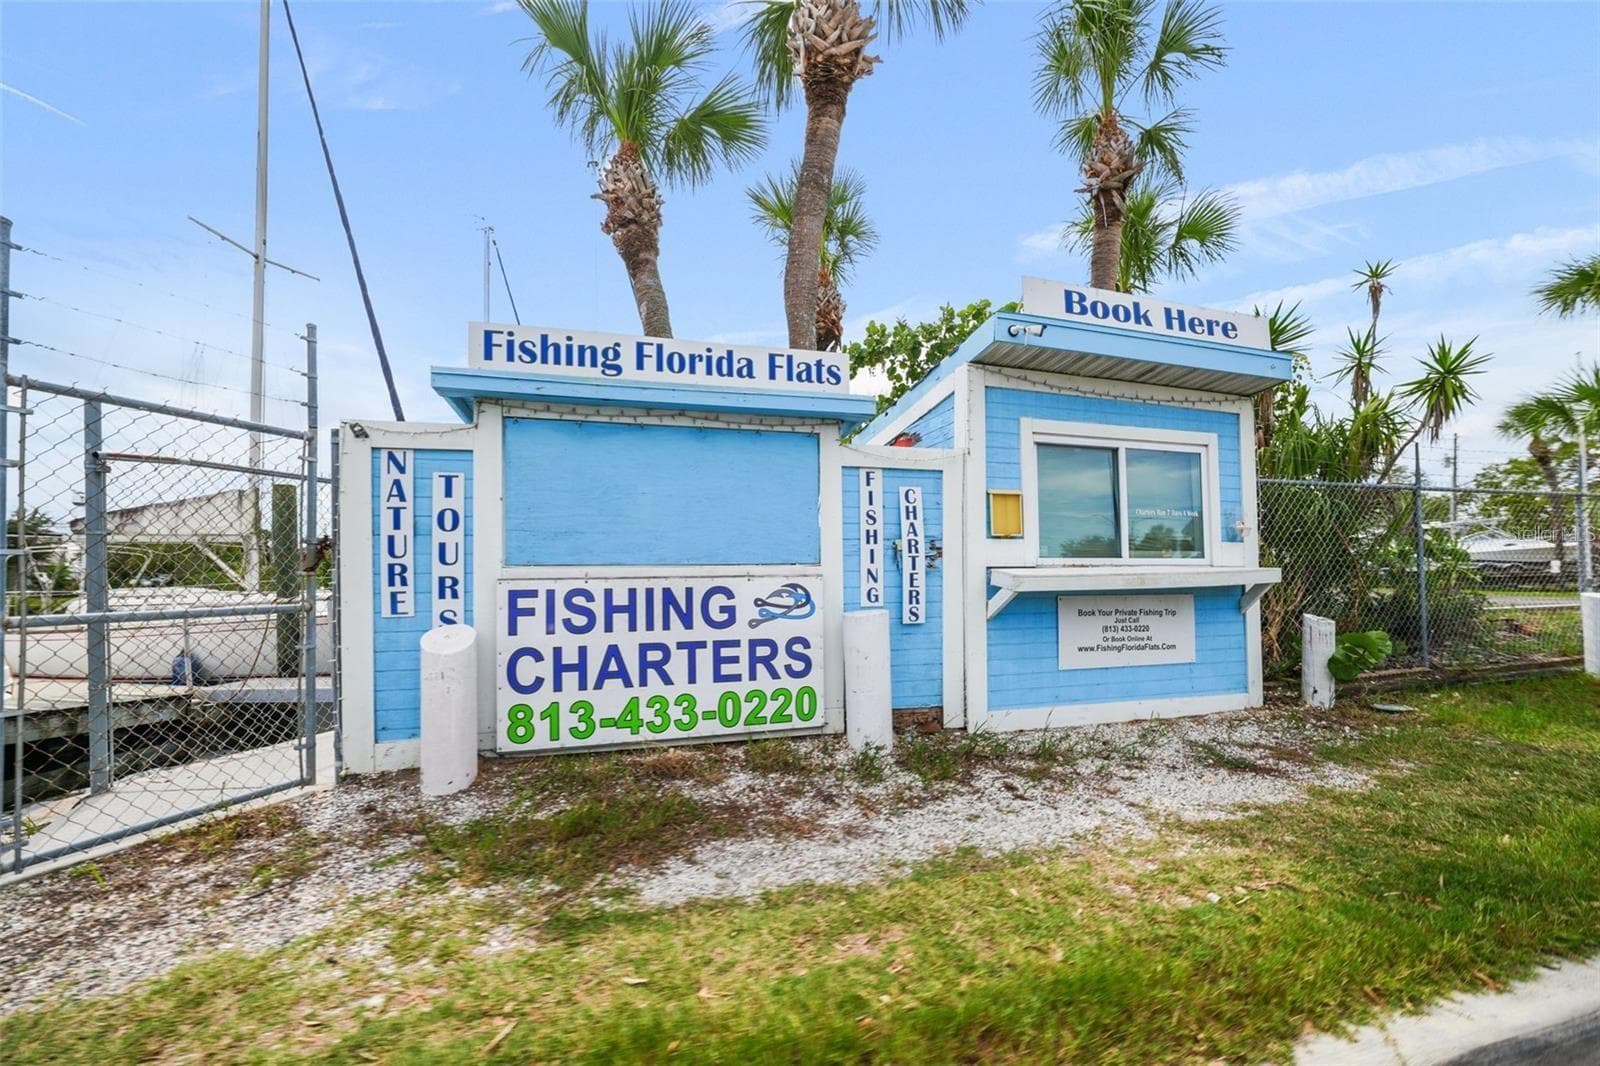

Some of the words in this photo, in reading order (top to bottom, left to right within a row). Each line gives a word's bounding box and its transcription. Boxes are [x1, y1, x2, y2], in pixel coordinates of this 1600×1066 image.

[1064, 289, 1152, 327] Book
[1163, 307, 1238, 339] Here
[483, 329, 623, 377] Fishing
[635, 341, 755, 379] Florida
[768, 353, 841, 386] Flats
[386, 451, 408, 615] NATURE
[437, 475, 460, 627] TOURS
[865, 471, 880, 604] FISHING
[904, 488, 921, 623] CHARTERS
[507, 585, 736, 637] FISHING
[1078, 608, 1096, 617] Book
[1097, 608, 1113, 617] Your
[1114, 608, 1138, 617] Private
[1139, 608, 1163, 618] Fishing
[1164, 608, 1177, 617] Trip
[1102, 625, 1119, 634] (813)
[1120, 625, 1150, 633] 433-0220
[506, 635, 813, 695] CHARTERS
[1077, 643, 1177, 653] www.FishingFloridaFlats.Com
[506, 685, 818, 745] 813-433-0220
